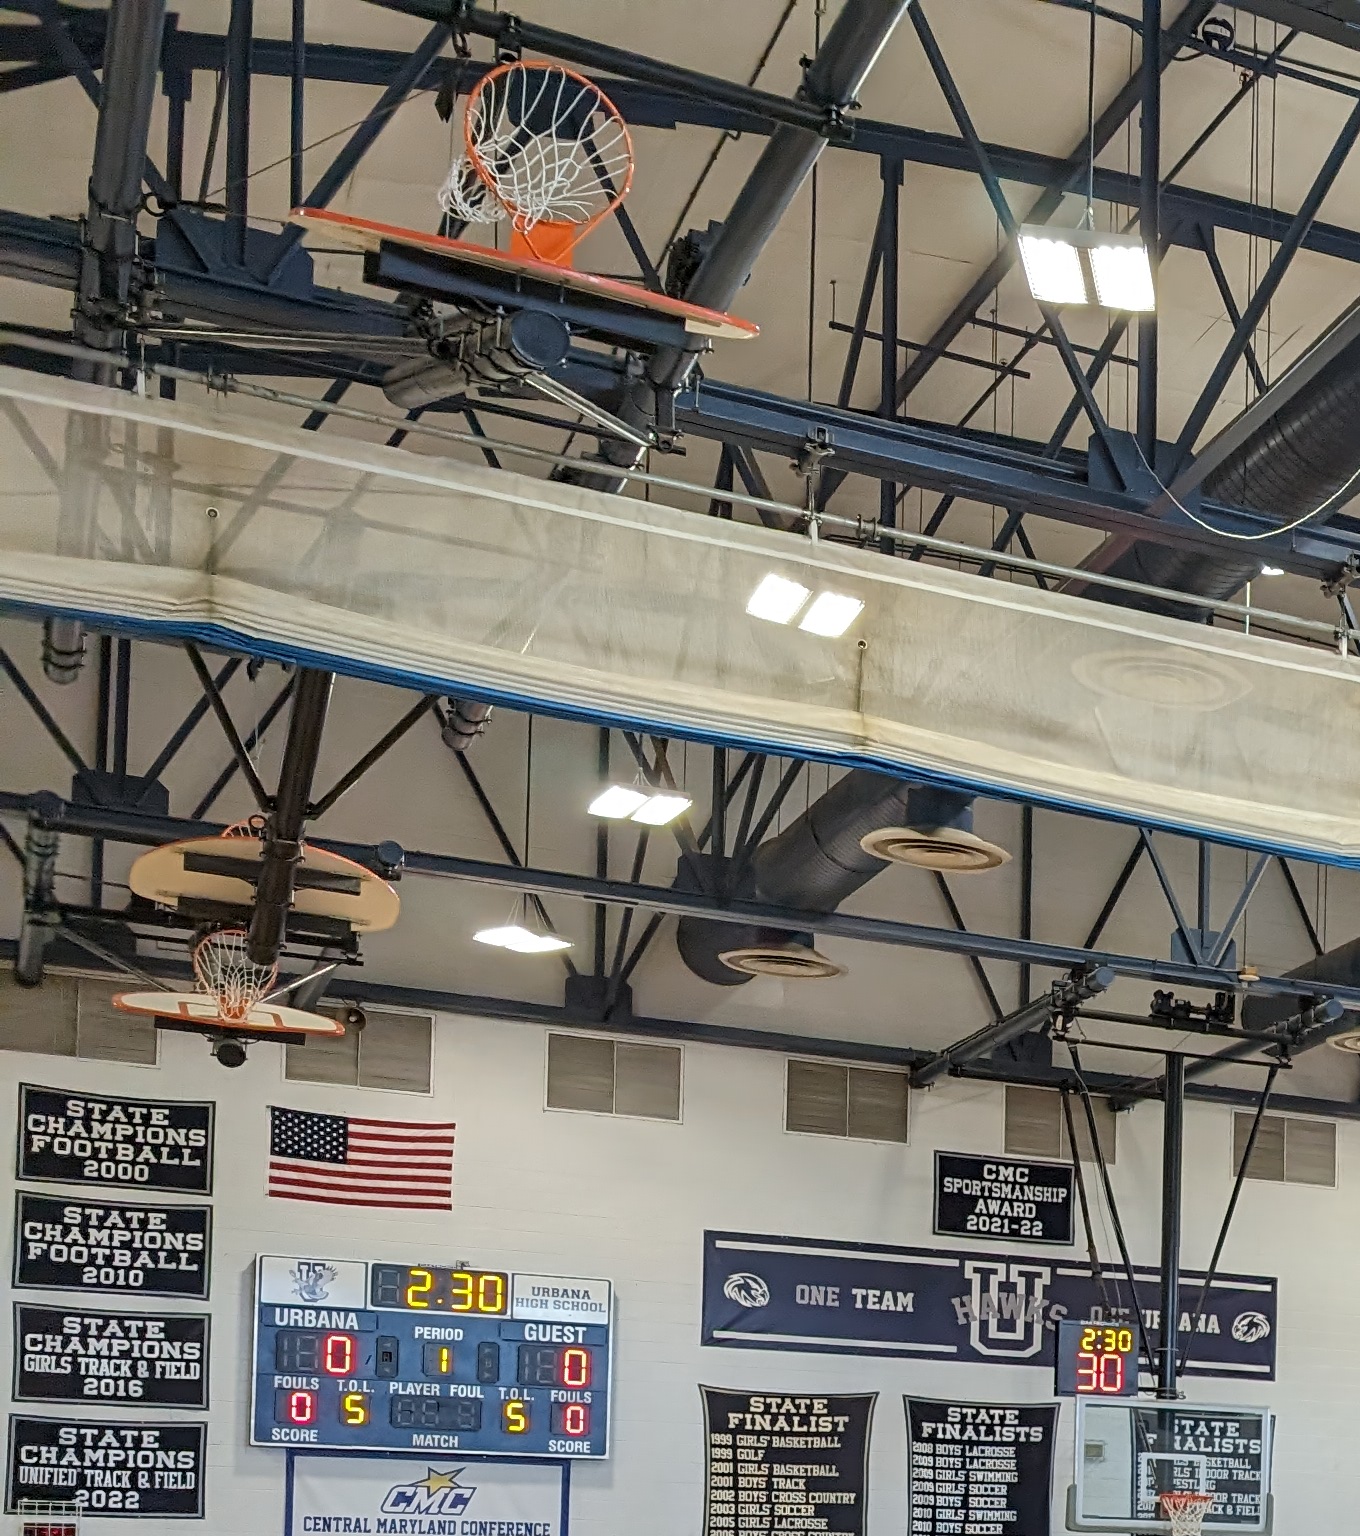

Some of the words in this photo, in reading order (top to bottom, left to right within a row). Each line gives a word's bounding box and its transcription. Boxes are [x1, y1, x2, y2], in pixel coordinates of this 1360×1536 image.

[66, 1099, 170, 1125] STATE
[27, 1114, 206, 1146] CHAMPIONS
[31, 1135, 200, 1166] FOOTBALL
[84, 1161, 149, 1182] 2000
[983, 1164, 1029, 1182] CMC
[943, 1178, 1068, 1203] SPORTSMANSHIP
[63, 1207, 167, 1230] STATE
[974, 1202, 1037, 1219] AWARD
[24, 1222, 203, 1250] CHAMPIONS
[966, 1216, 1044, 1237] 2021-22
[27, 1242, 198, 1271] FOOTBALL
[82, 1267, 143, 1286] 2010
[531, 1286, 591, 1300] URBANA
[795, 1284, 840, 1308] ONE
[852, 1289, 914, 1313] TEAM
[515, 1298, 550, 1310] HIGH
[552, 1300, 606, 1313] SCHOOL
[951, 1293, 1068, 1331] HAWKS
[965, 1260, 1051, 1358] U
[63, 1317, 165, 1338] STATE
[275, 1308, 358, 1330] URBANA
[414, 1327, 464, 1341] PERIOD
[524, 1324, 587, 1343] GUEST
[1082, 1329, 1131, 1351] 2:30
[25, 1334, 200, 1360] CHAMPIONS
[326, 1336, 351, 1373] 0
[24, 1354, 72, 1374] GIRLS
[78, 1359, 132, 1377] TRACK
[137, 1361, 149, 1378] &
[155, 1361, 200, 1379] FIELD
[440, 1348, 447, 1372] 1
[564, 1350, 587, 1385] 0
[1078, 1353, 1122, 1392] 30
[84, 1378, 143, 1397] 2016
[274, 1376, 319, 1390] FOULS
[337, 1380, 375, 1393] T.O.L.
[390, 1382, 440, 1395] PLAYER
[450, 1385, 485, 1398] FOUL
[498, 1388, 534, 1401] T.O.L.
[550, 1390, 592, 1403] FOULS
[291, 1392, 311, 1422] 0
[750, 1397, 828, 1414] STATE
[947, 1407, 1019, 1424] STATE
[565, 1406, 584, 1433] 0
[727, 1413, 849, 1432] FINALIST
[59, 1428, 160, 1448] STATE
[271, 1428, 318, 1442] SCORE
[412, 1434, 458, 1448] MATCH
[711, 1434, 732, 1445] 1999
[772, 1436, 841, 1448] BASKETBALL
[922, 1422, 1043, 1442] FINALISTS
[548, 1440, 591, 1453] SCORE
[20, 1446, 195, 1469] CHAMPIONS
[84, 1470, 131, 1488] TRACK
[138, 1471, 150, 1488] &
[155, 1472, 195, 1489] FIELD
[75, 1490, 139, 1509] 2022
[381, 1485, 477, 1516] CMC
[711, 1490, 735, 1501] 2002
[771, 1492, 806, 1503] CROSS
[809, 1493, 856, 1504] COUNTRY
[303, 1516, 371, 1533] CENTRAL
[377, 1519, 456, 1536] MARYLAND
[461, 1521, 550, 1536] CONFERENCE
